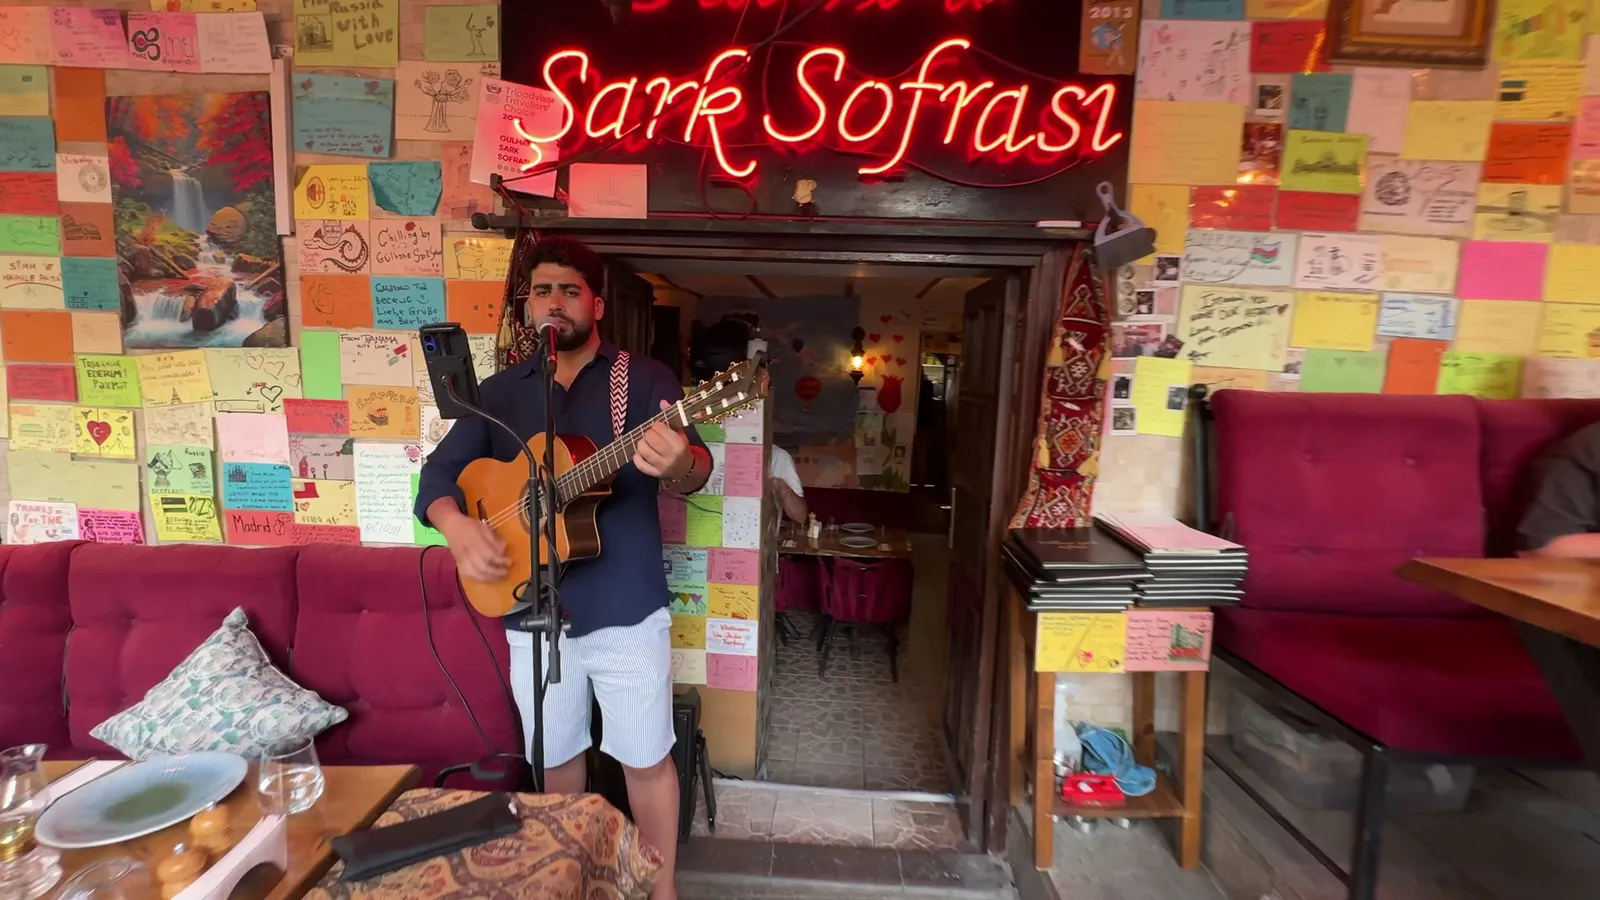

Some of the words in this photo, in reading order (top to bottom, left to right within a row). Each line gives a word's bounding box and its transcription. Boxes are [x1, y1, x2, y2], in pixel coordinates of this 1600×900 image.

[505, 86, 556, 105] Tripadvisor
[503, 104, 536, 118] Choice
[498, 144, 520, 155] SARK
[377, 227, 419, 249] Chilling
[184, 447, 205, 456] Russia
[231, 515, 272, 533] Madrid
